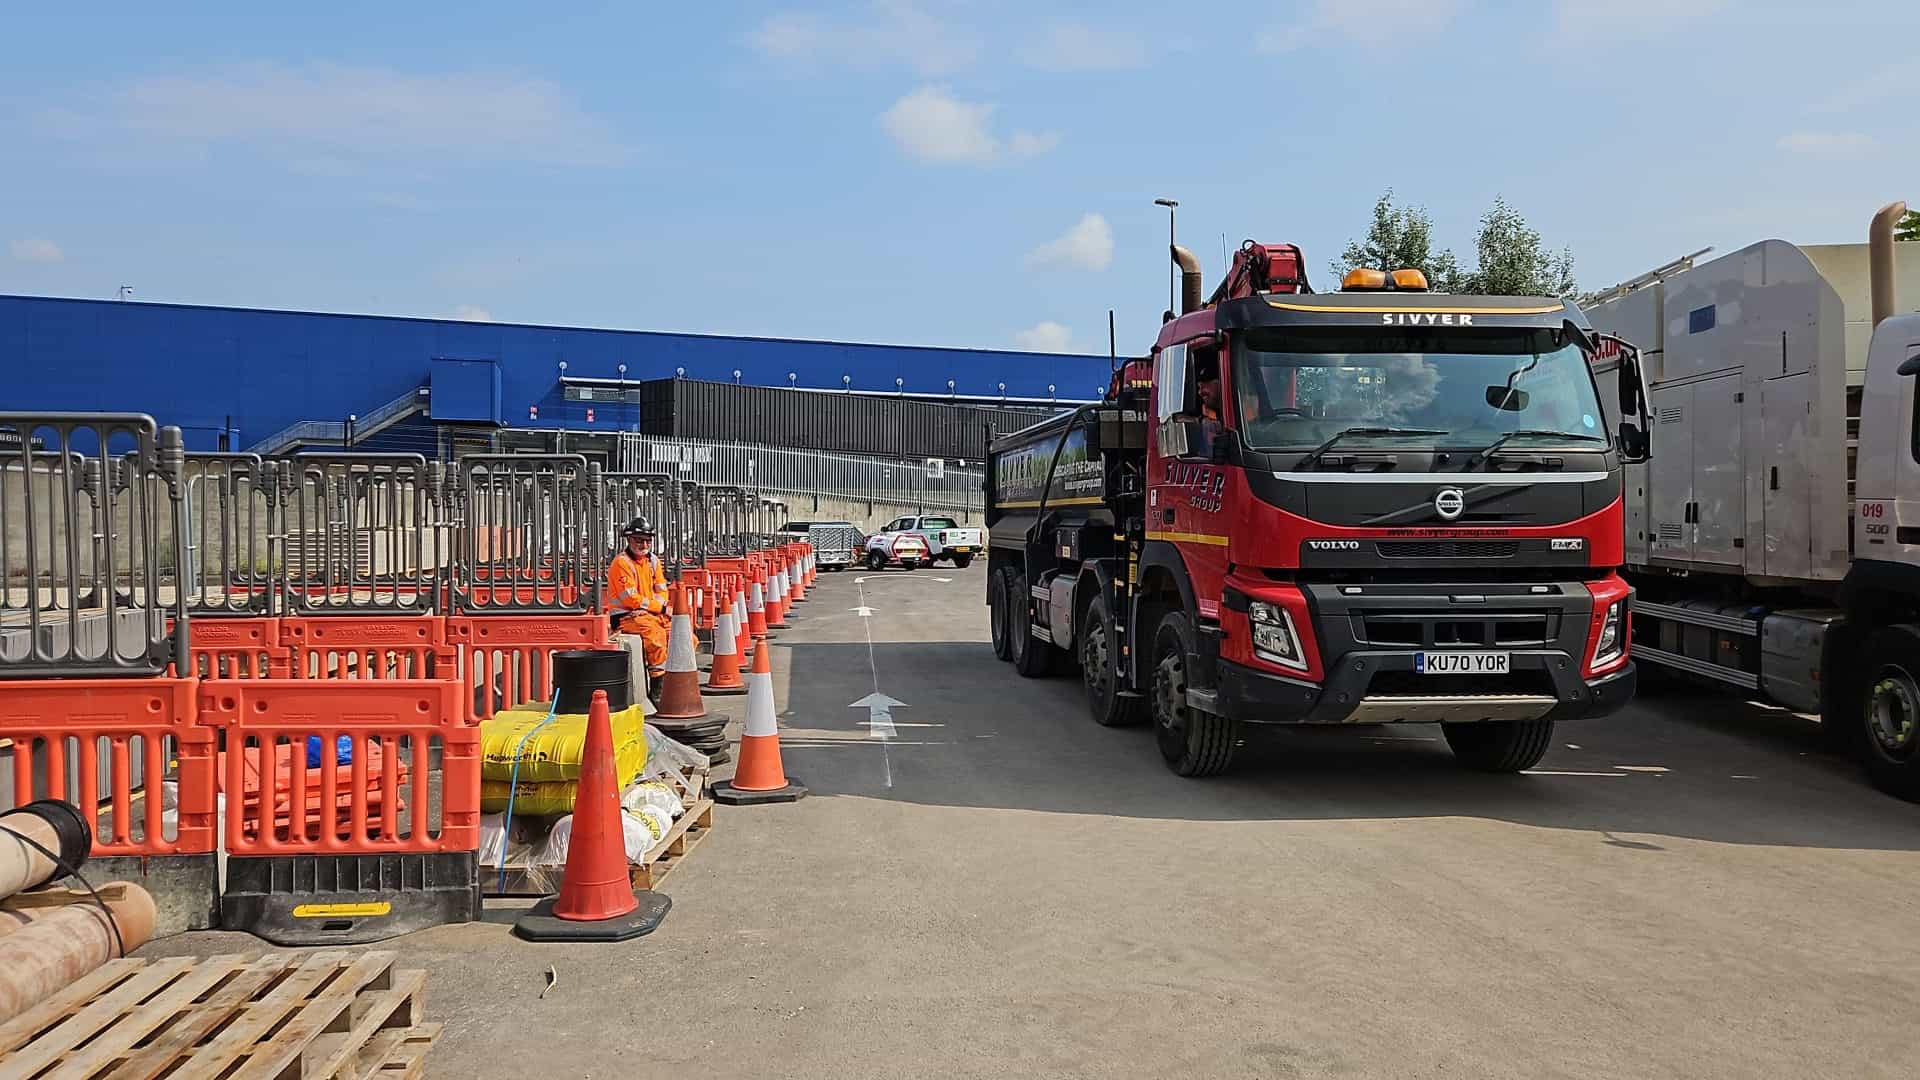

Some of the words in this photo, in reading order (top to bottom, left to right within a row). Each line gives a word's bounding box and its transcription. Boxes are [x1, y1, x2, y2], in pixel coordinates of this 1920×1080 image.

[1382, 313, 1472, 326] SIVYER
[1862, 503, 1883, 518] 019
[1865, 524, 1889, 534] 500
[1309, 541, 1360, 550] VOLVO
[1427, 655, 1471, 671] KU70
[1475, 655, 1506, 671] YOR
